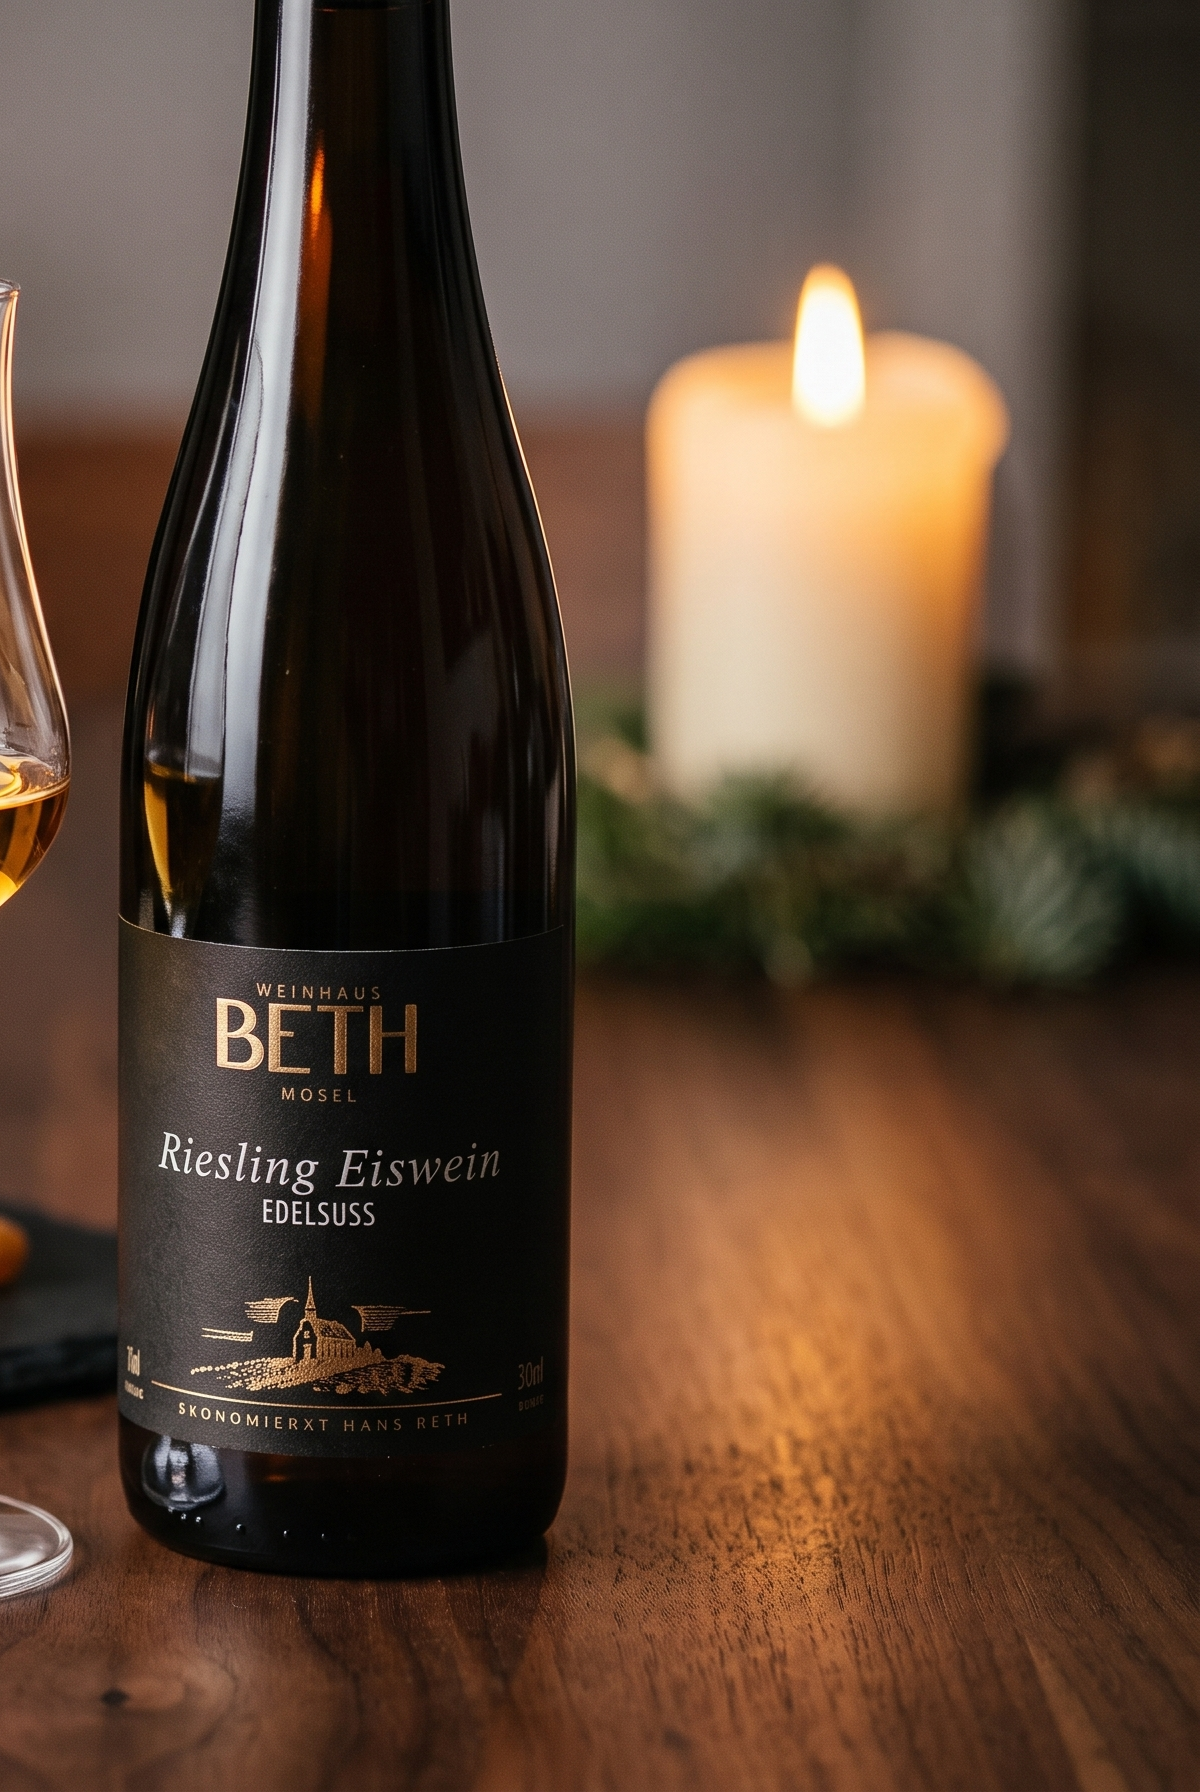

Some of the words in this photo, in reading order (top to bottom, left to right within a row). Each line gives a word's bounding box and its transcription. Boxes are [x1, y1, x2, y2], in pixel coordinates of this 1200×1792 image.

[256, 982, 381, 1000] WEINHAUS
[216, 997, 417, 1075] BETH
[281, 1086, 356, 1103] MOSEL
[158, 1131, 319, 1195] Riesling
[336, 1142, 501, 1188] Eiswein
[262, 1199, 376, 1227] EDELSUSS
[178, 1402, 329, 1431] SKONOMIERXT
[343, 1419, 402, 1432] HANS
[417, 1412, 467, 1430] RETH
